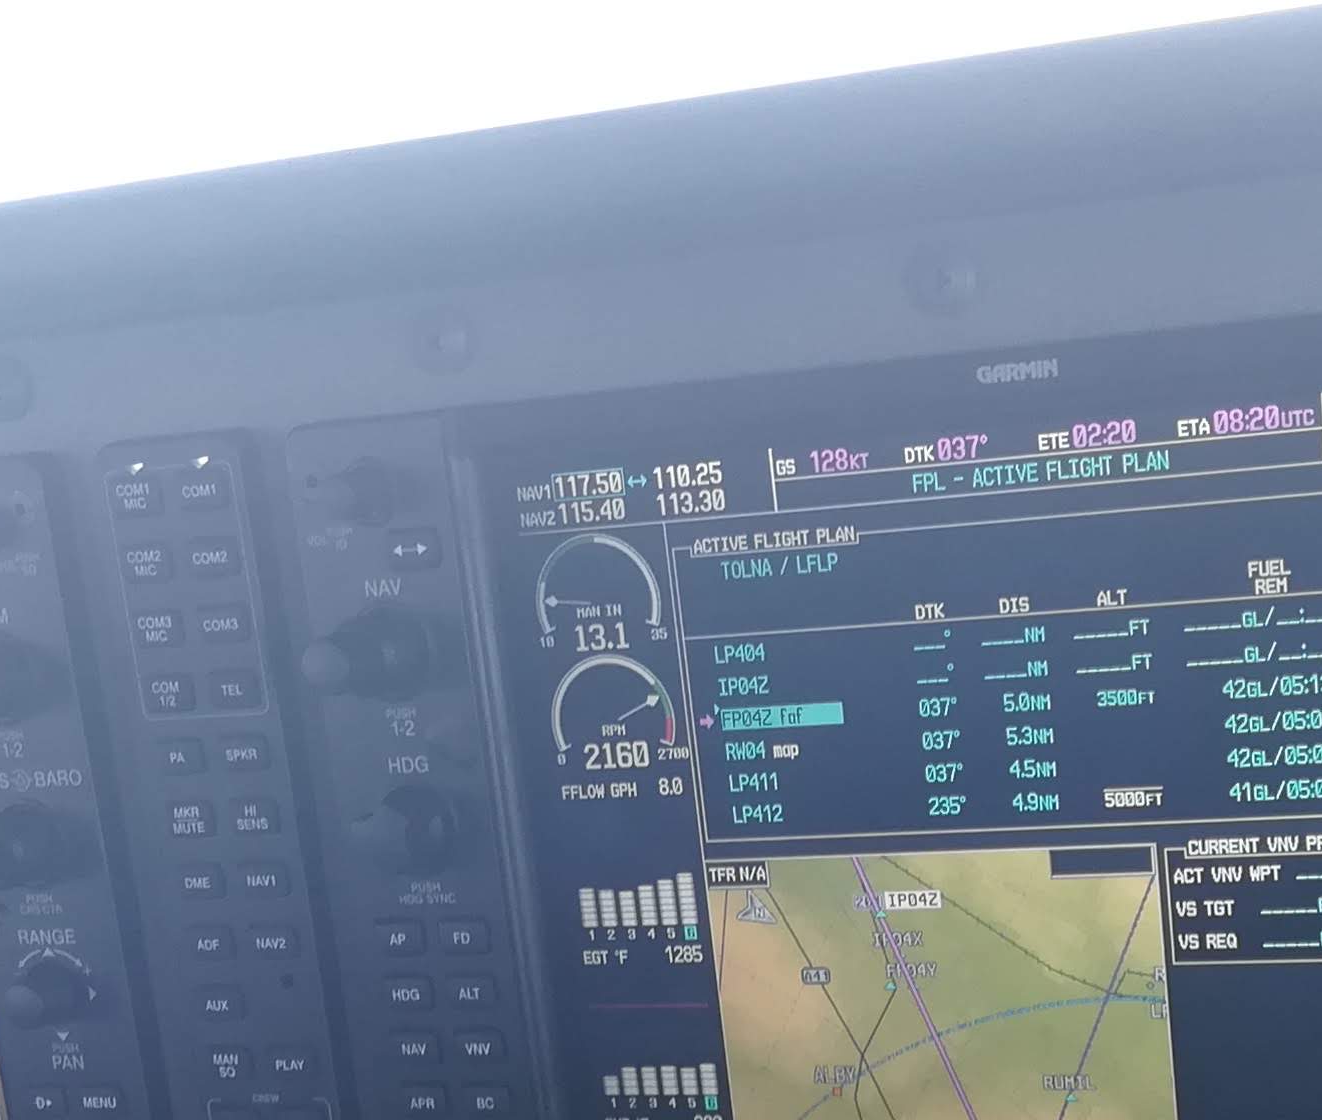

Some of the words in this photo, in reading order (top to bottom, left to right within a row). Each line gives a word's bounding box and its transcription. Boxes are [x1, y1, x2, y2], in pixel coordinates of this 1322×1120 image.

[976, 359, 1058, 384] GARMIN
[1038, 432, 1069, 451] ETE
[1072, 420, 1136, 448] 02:20
[1177, 418, 1210, 437] ETA
[904, 446, 934, 464] DTK
[776, 459, 796, 475] GS
[913, 472, 946, 493] FPL
[973, 464, 1038, 487] ACTIVE
[1046, 456, 1112, 482] FLIGHT
[1122, 450, 1169, 474] PLAN
[182, 484, 216, 498] COM1
[516, 485, 552, 502] NAV1
[555, 473, 622, 497] 117.50
[652, 462, 723, 490] 110.25
[520, 511, 556, 527] NAV2
[558, 502, 625, 524] 115.40
[657, 491, 725, 516] 113.30
[693, 537, 748, 554] ACTIVE
[753, 533, 809, 549] FLIGHT
[816, 528, 855, 545] PLAN
[192, 551, 228, 565] COM2
[720, 559, 772, 579] TOLNA
[796, 554, 838, 574] LFLP
[1248, 559, 1291, 577] FUEL
[365, 578, 401, 598] NAV
[1254, 579, 1287, 595] REM
[915, 604, 945, 621] DTK
[999, 597, 1030, 614] DIS
[1096, 590, 1128, 607] ALT
[575, 623, 630, 651] 13.1
[714, 644, 765, 664] LP404
[583, 741, 649, 770] 2160
[726, 742, 766, 761] RW04
[773, 742, 799, 759] map
[389, 756, 428, 773] HDG
[561, 784, 605, 800] FFLOW
[610, 782, 637, 798] GPH
[659, 777, 683, 795] 8.0
[729, 773, 778, 792] LP411
[1188, 838, 1259, 855] CURRENT
[1267, 836, 1299, 852] VNV
[709, 867, 736, 882] TFR
[739, 866, 766, 880] N/A
[665, 946, 703, 964] 1285
[465, 1042, 490, 1055] VNV
